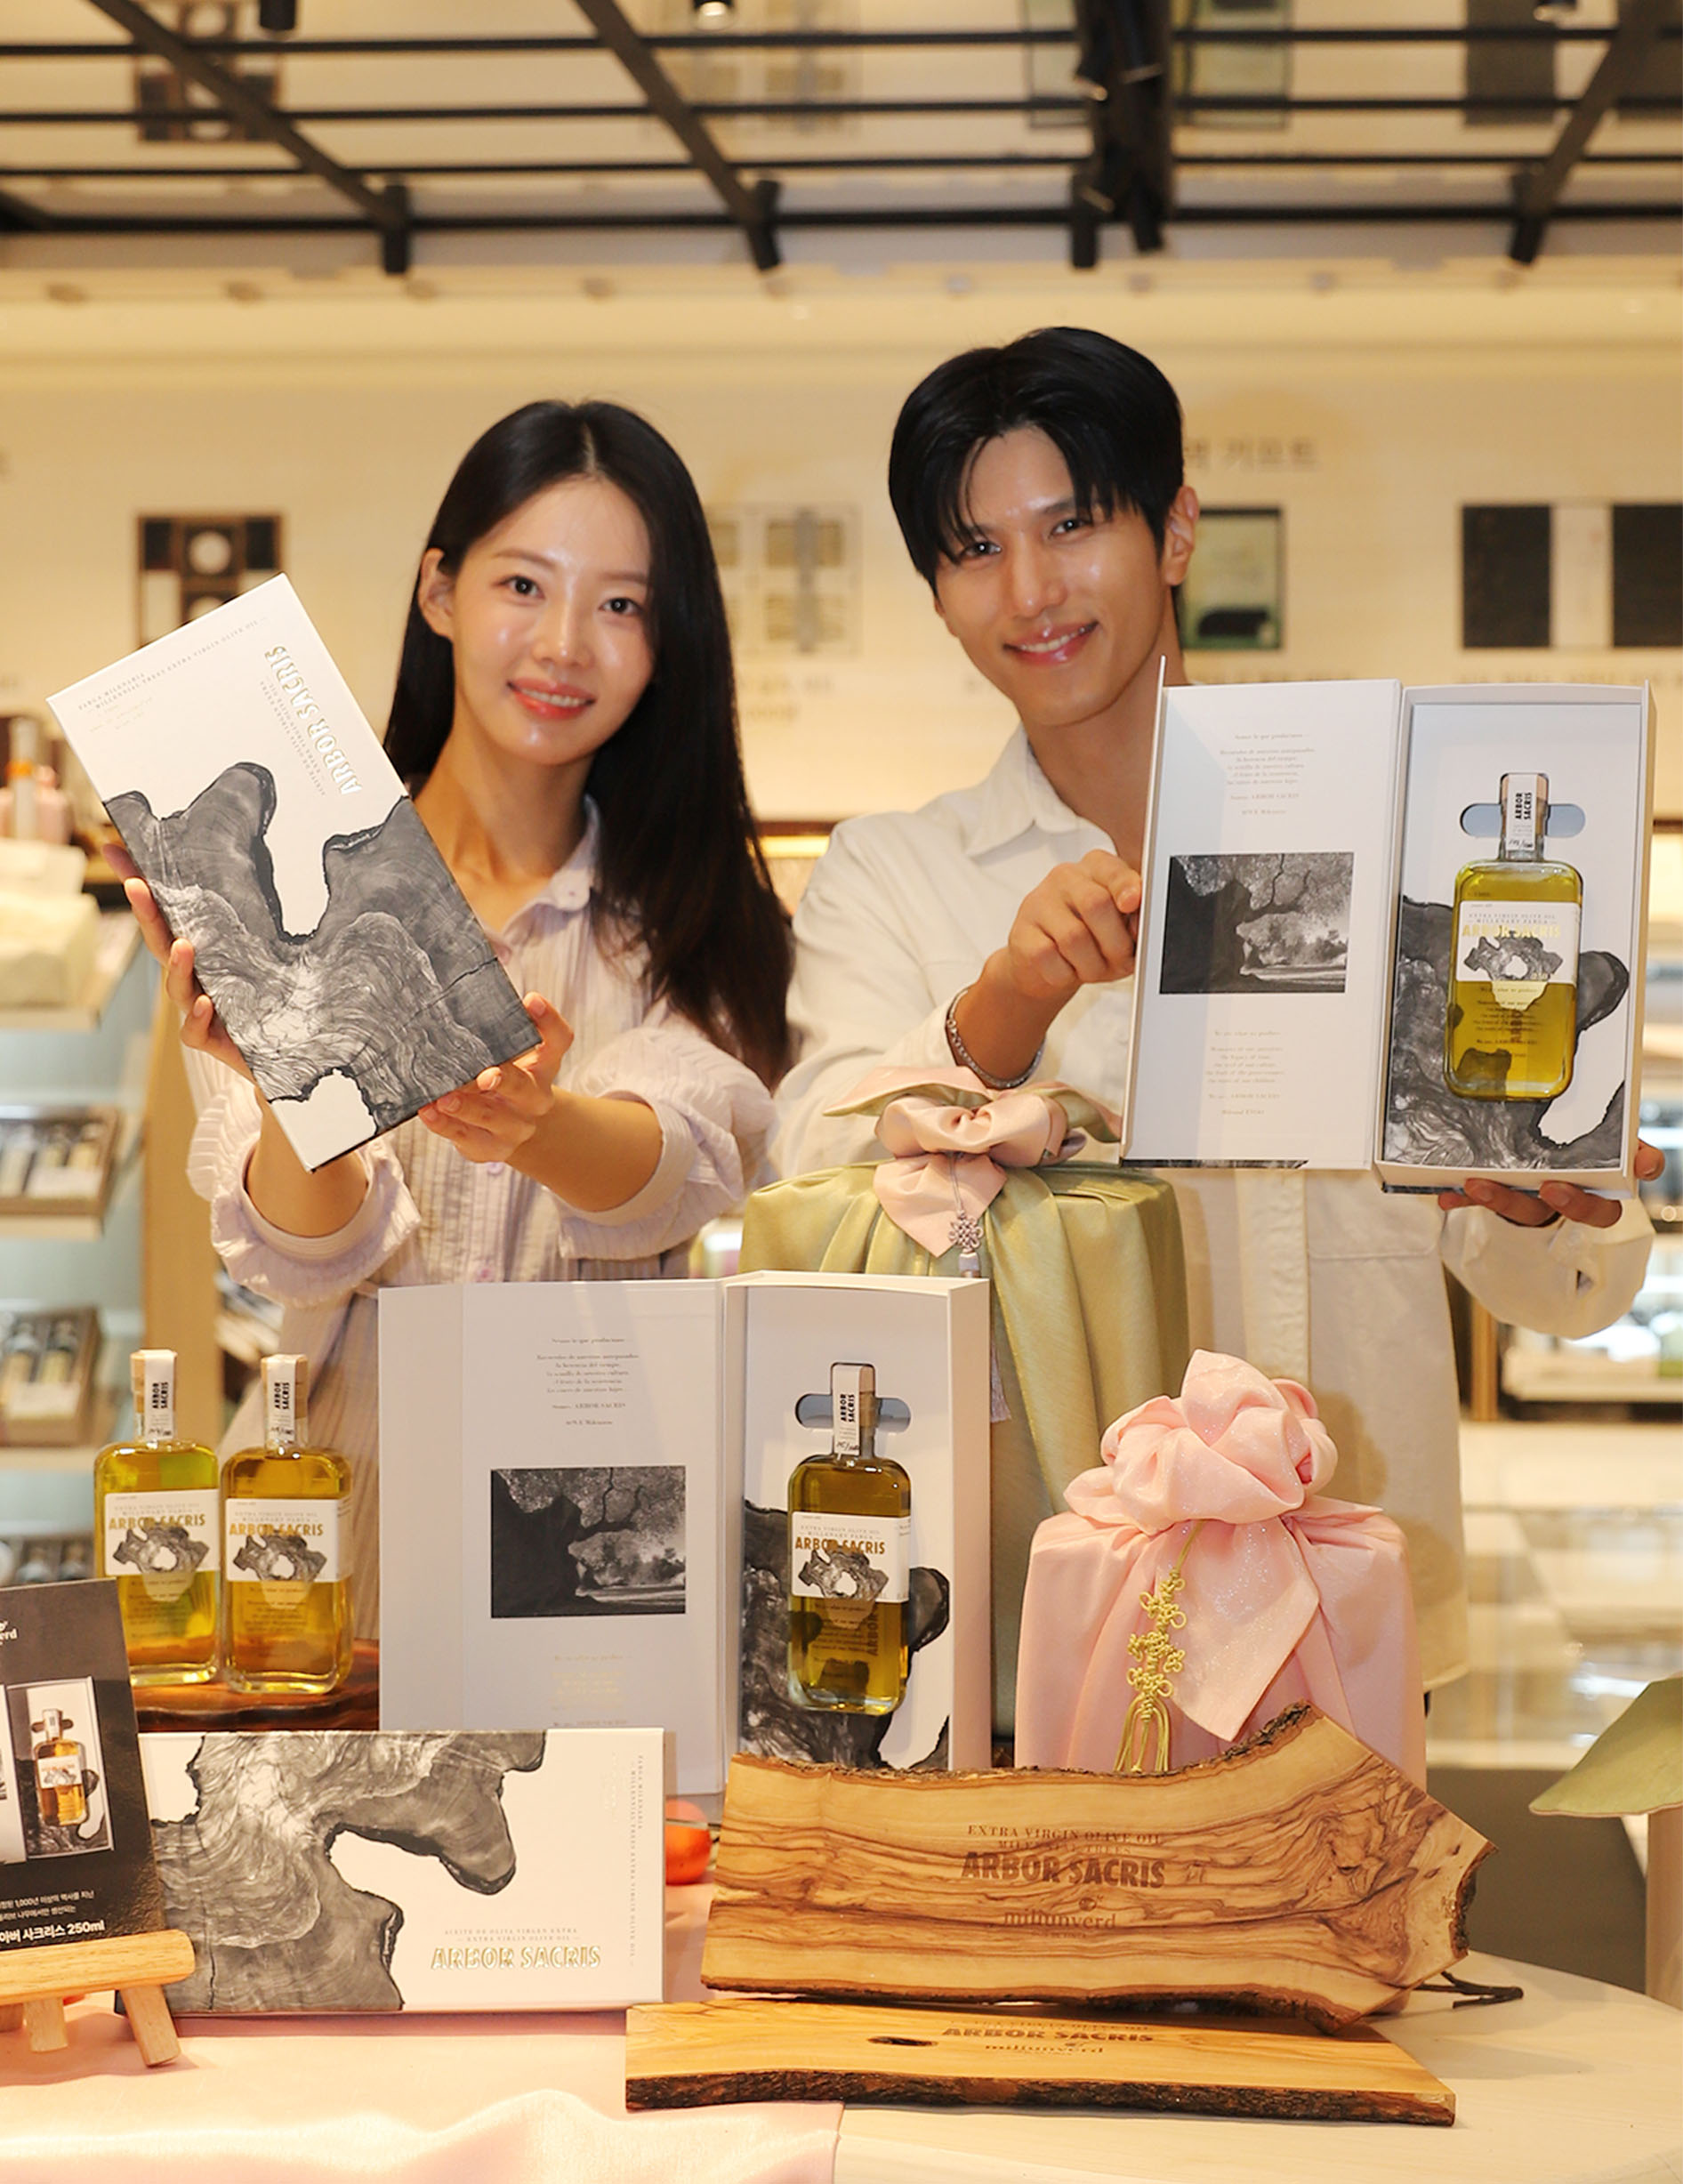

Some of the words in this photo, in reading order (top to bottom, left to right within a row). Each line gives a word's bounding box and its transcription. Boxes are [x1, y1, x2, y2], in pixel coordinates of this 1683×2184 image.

[265, 646, 319, 717] SACRIS
[310, 720, 362, 795] ARBOR
[1515, 793, 1523, 819] ARBOR
[1524, 792, 1532, 819] SACRIS
[1462, 924, 1510, 937] ARBOR
[1514, 925, 1560, 938] SACRIS
[282, 1382, 290, 1409] SACRIS
[230, 1523, 274, 1535] ARBOR
[278, 1523, 324, 1536] SACRIS
[968, 1825, 1019, 1837] EXTRA
[1025, 1827, 1079, 1840] VIRGIN
[1084, 1830, 1133, 1843] OLIVE
[1136, 1833, 1161, 1844] OIL
[962, 1852, 1061, 1883] ARBOR
[1068, 1858, 1165, 1889] SACRIS
[0, 1930, 21, 1944] 아버
[22, 1924, 66, 1940] 사크리스
[67, 1920, 106, 1935] 250ml
[431, 1946, 514, 1970] ARBOR
[520, 1945, 601, 1969] SACRIS
[942, 2027, 1045, 2039] ARBOR
[1054, 2031, 1154, 2043] SACRIS
